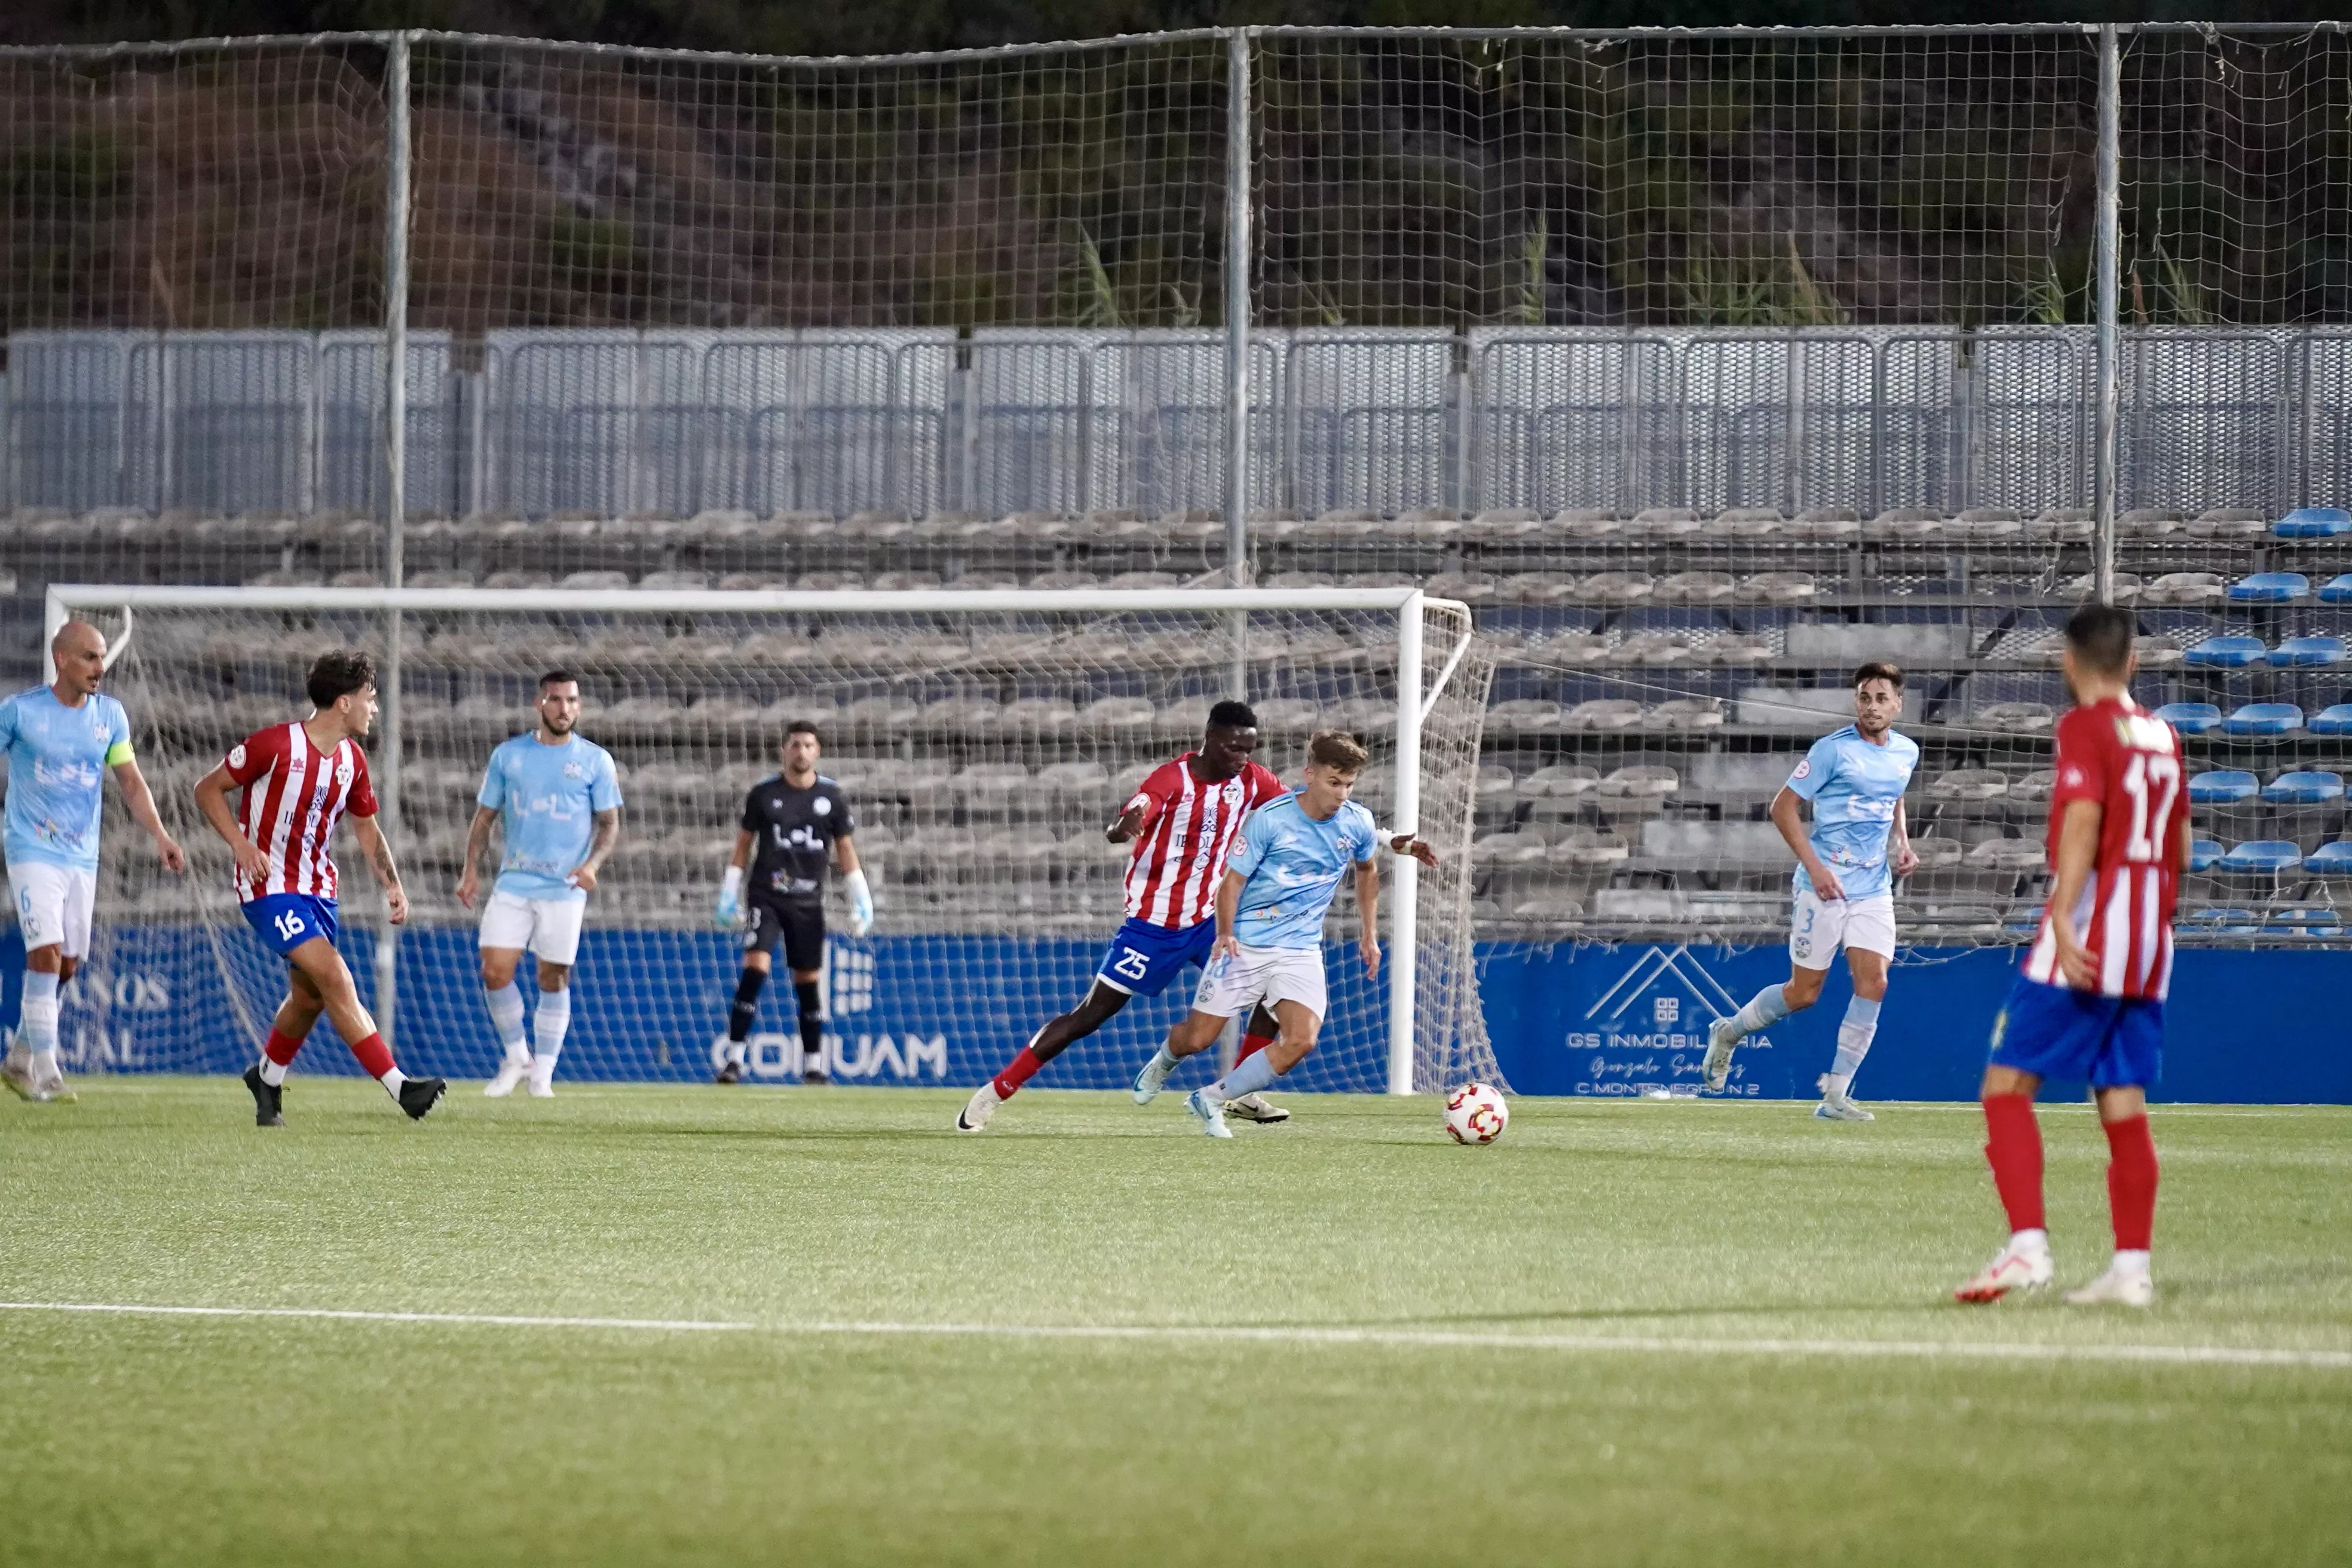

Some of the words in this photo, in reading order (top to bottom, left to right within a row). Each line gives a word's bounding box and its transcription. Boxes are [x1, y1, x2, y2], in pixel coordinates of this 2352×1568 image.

[2123, 753, 2180, 863] 17
[20, 885, 31, 914] 6
[274, 909, 306, 942] 16
[1800, 908, 1815, 933] 3
[1113, 947, 1151, 981] 25
[1568, 1033, 1601, 1048] GS
[1607, 1034, 1773, 1049] INMOBILRIA
[1747, 1082, 1761, 1095] 2
